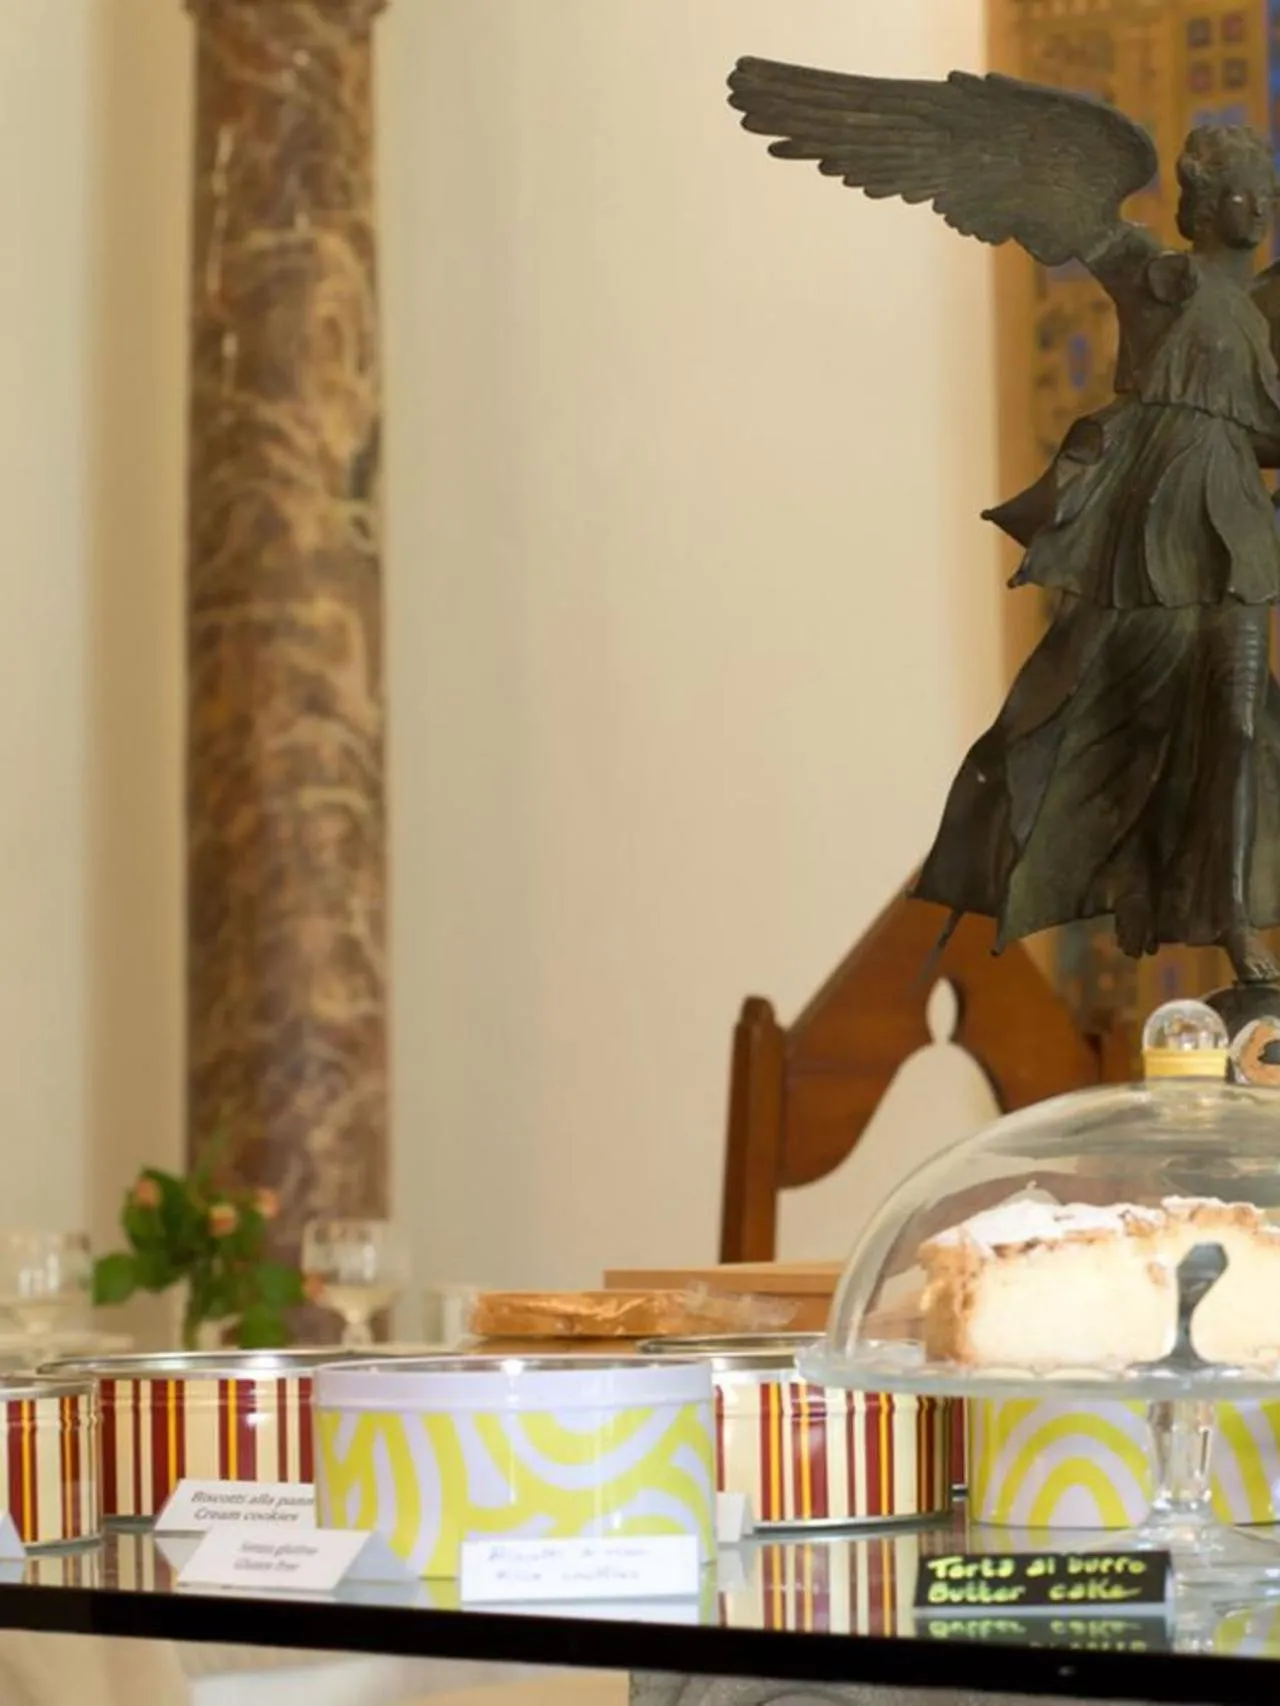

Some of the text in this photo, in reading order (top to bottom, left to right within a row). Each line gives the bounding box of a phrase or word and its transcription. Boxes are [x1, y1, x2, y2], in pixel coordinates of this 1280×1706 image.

[248, 1493, 275, 1505] alla
[275, 1496, 314, 1509] pann
[194, 1507, 299, 1522] Cream cookies
[928, 1556, 1015, 1579] Torta
[1067, 1555, 1147, 1575] burro
